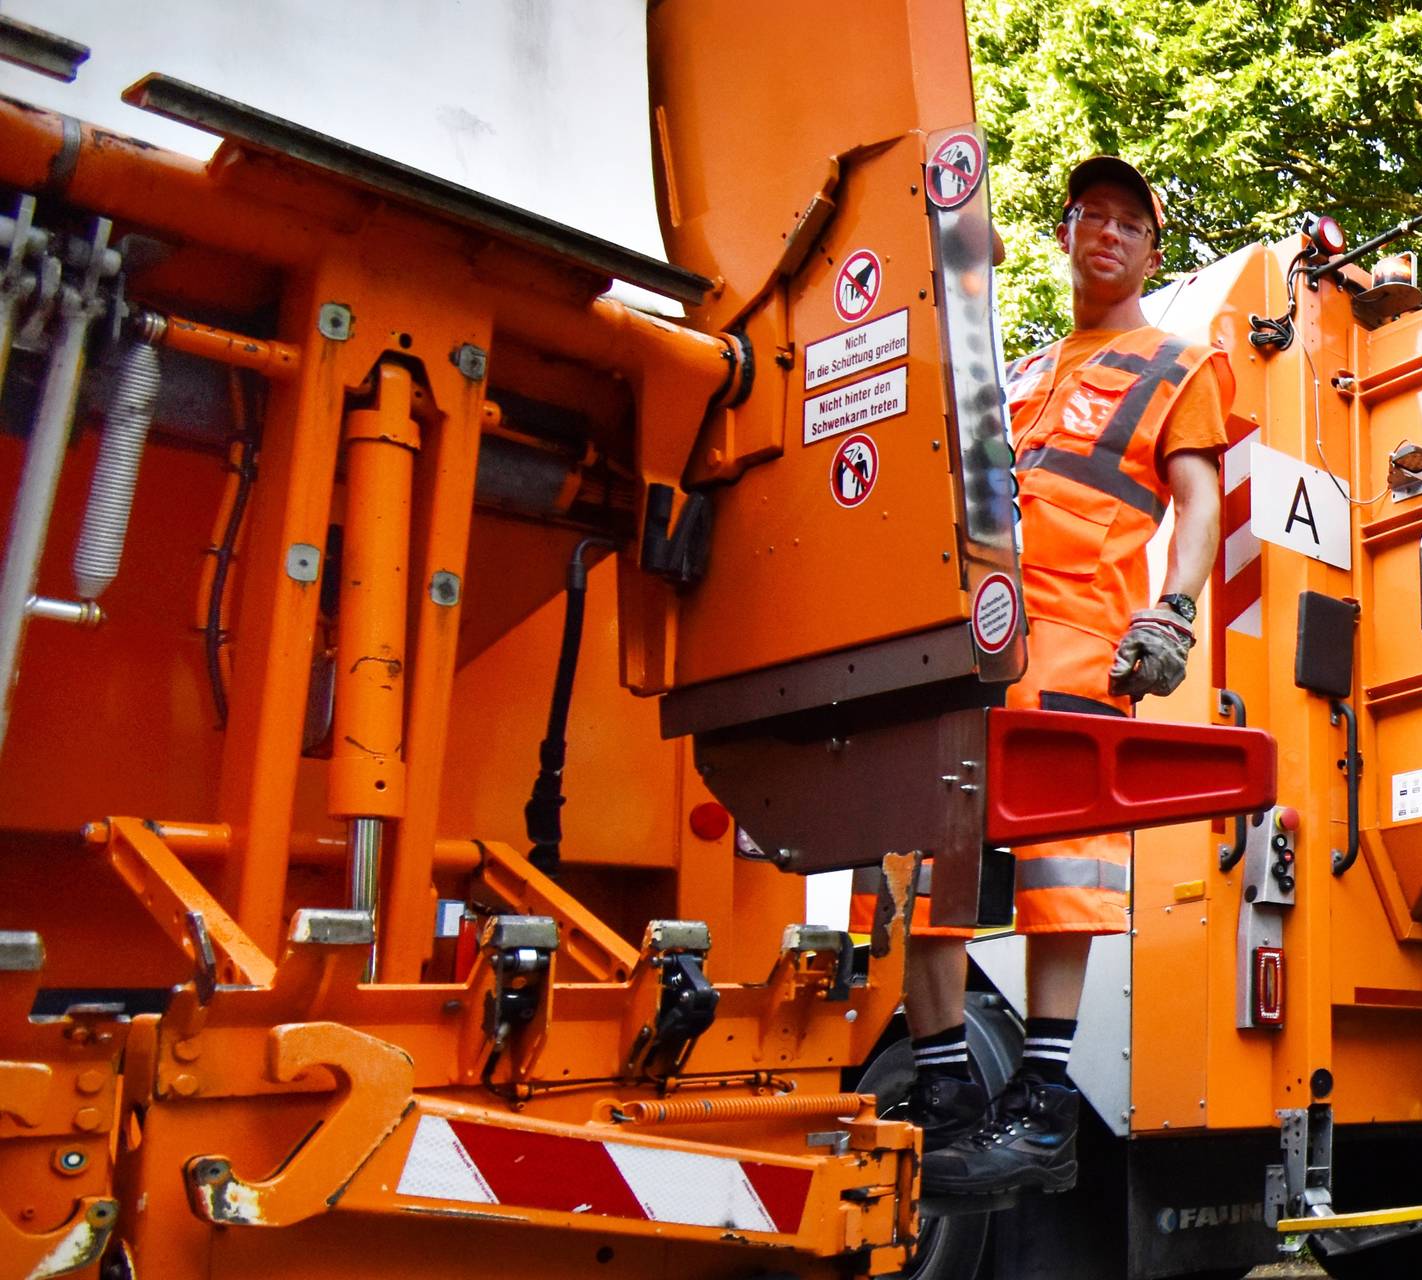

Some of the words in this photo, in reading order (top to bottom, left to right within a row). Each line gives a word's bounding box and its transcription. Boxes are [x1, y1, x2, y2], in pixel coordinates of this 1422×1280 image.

[808, 369, 815, 381] in
[817, 364, 829, 378] die
[875, 337, 906, 359] greifen
[845, 333, 867, 350] Nicht
[812, 409, 868, 436] Schwenkarm
[870, 398, 898, 416] treten
[819, 397, 842, 415] Nicht
[845, 387, 871, 406] hinter
[874, 381, 891, 395] den
[1285, 476, 1320, 545] A
